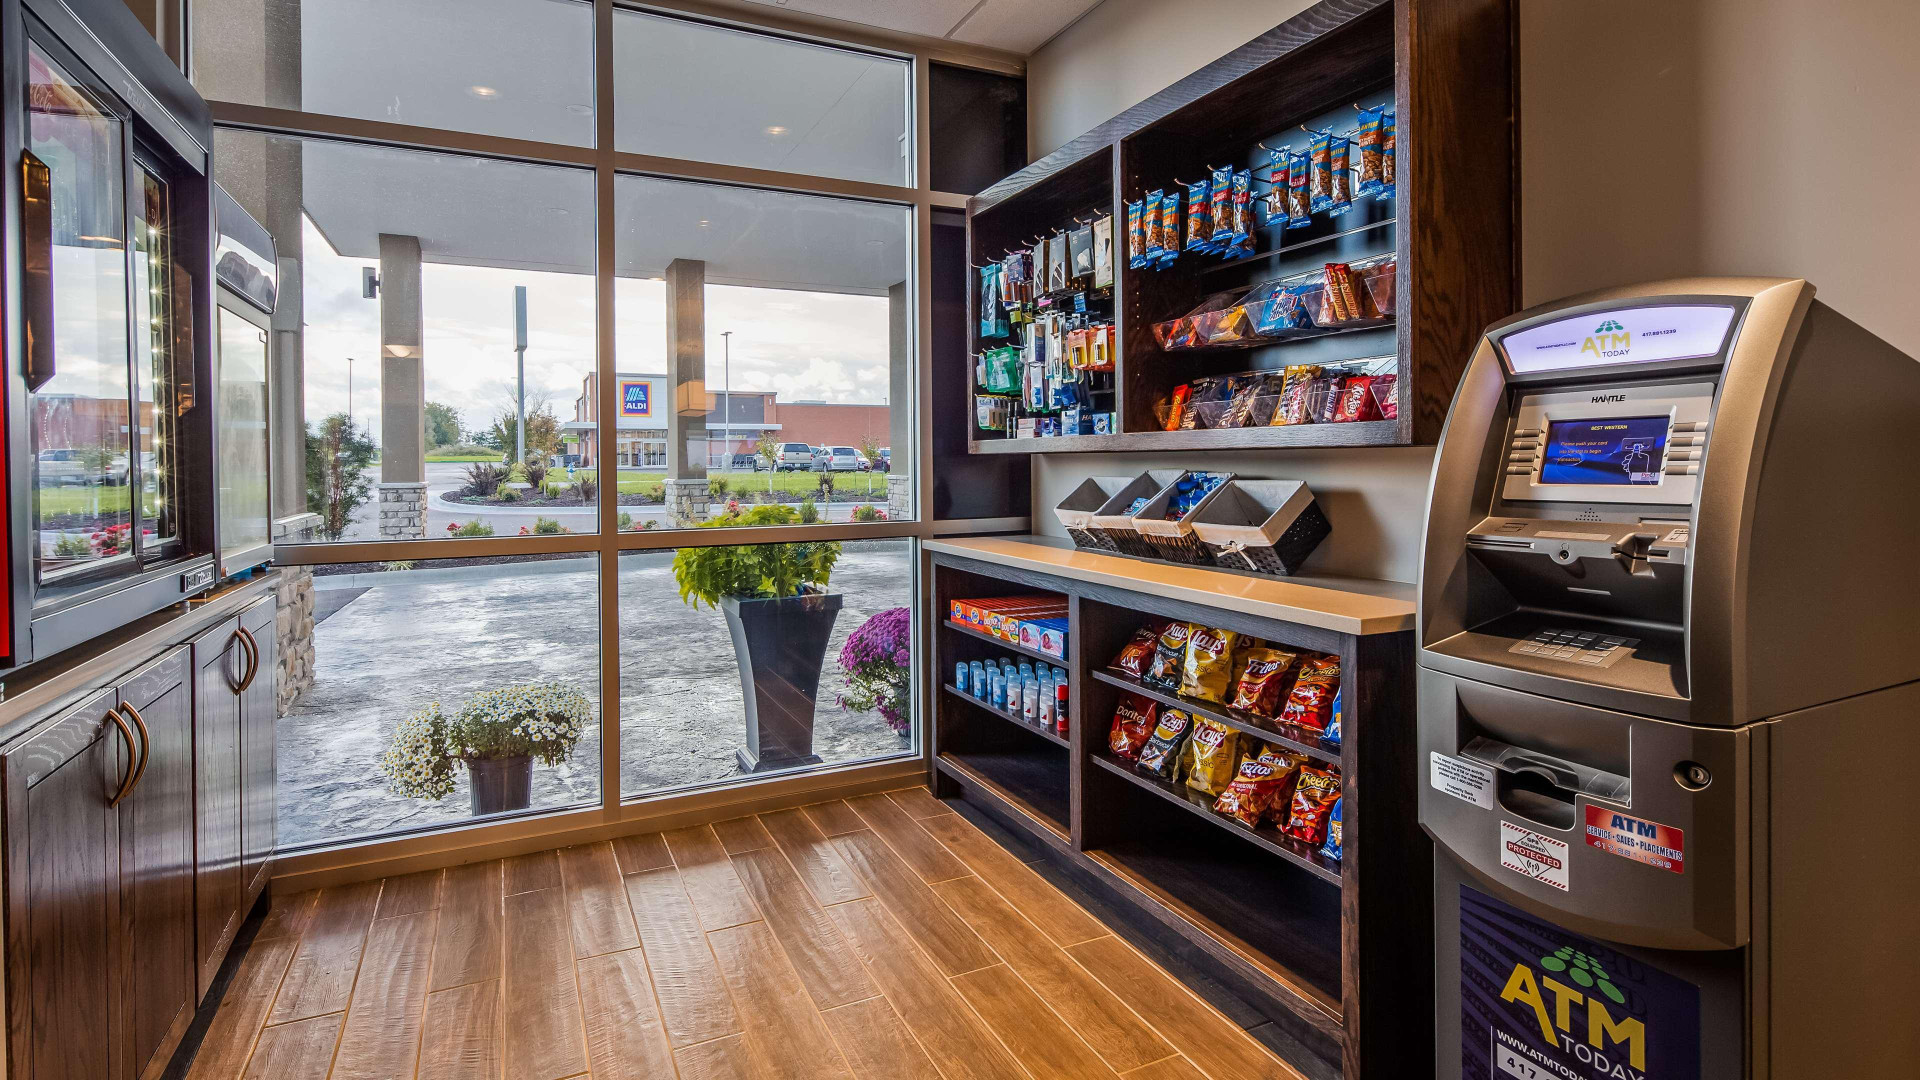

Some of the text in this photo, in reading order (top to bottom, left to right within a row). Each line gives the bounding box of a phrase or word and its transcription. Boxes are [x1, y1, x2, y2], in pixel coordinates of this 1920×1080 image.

[1580, 331, 1631, 358] ATM
[1602, 348, 1630, 358] TODAY
[626, 402, 647, 410] ALDI
[1591, 394, 1626, 404] HANTLE
[1246, 660, 1281, 675] Fritos
[1611, 814, 1656, 839] ATM
[1521, 841, 1545, 853] EQUIPPED
[1527, 837, 1539, 845] GPS
[1587, 825, 1682, 861] SERVICE SALES PLACEMENTS
[1508, 843, 1560, 868] PROTECTED
[1500, 963, 1645, 1072] ATM
